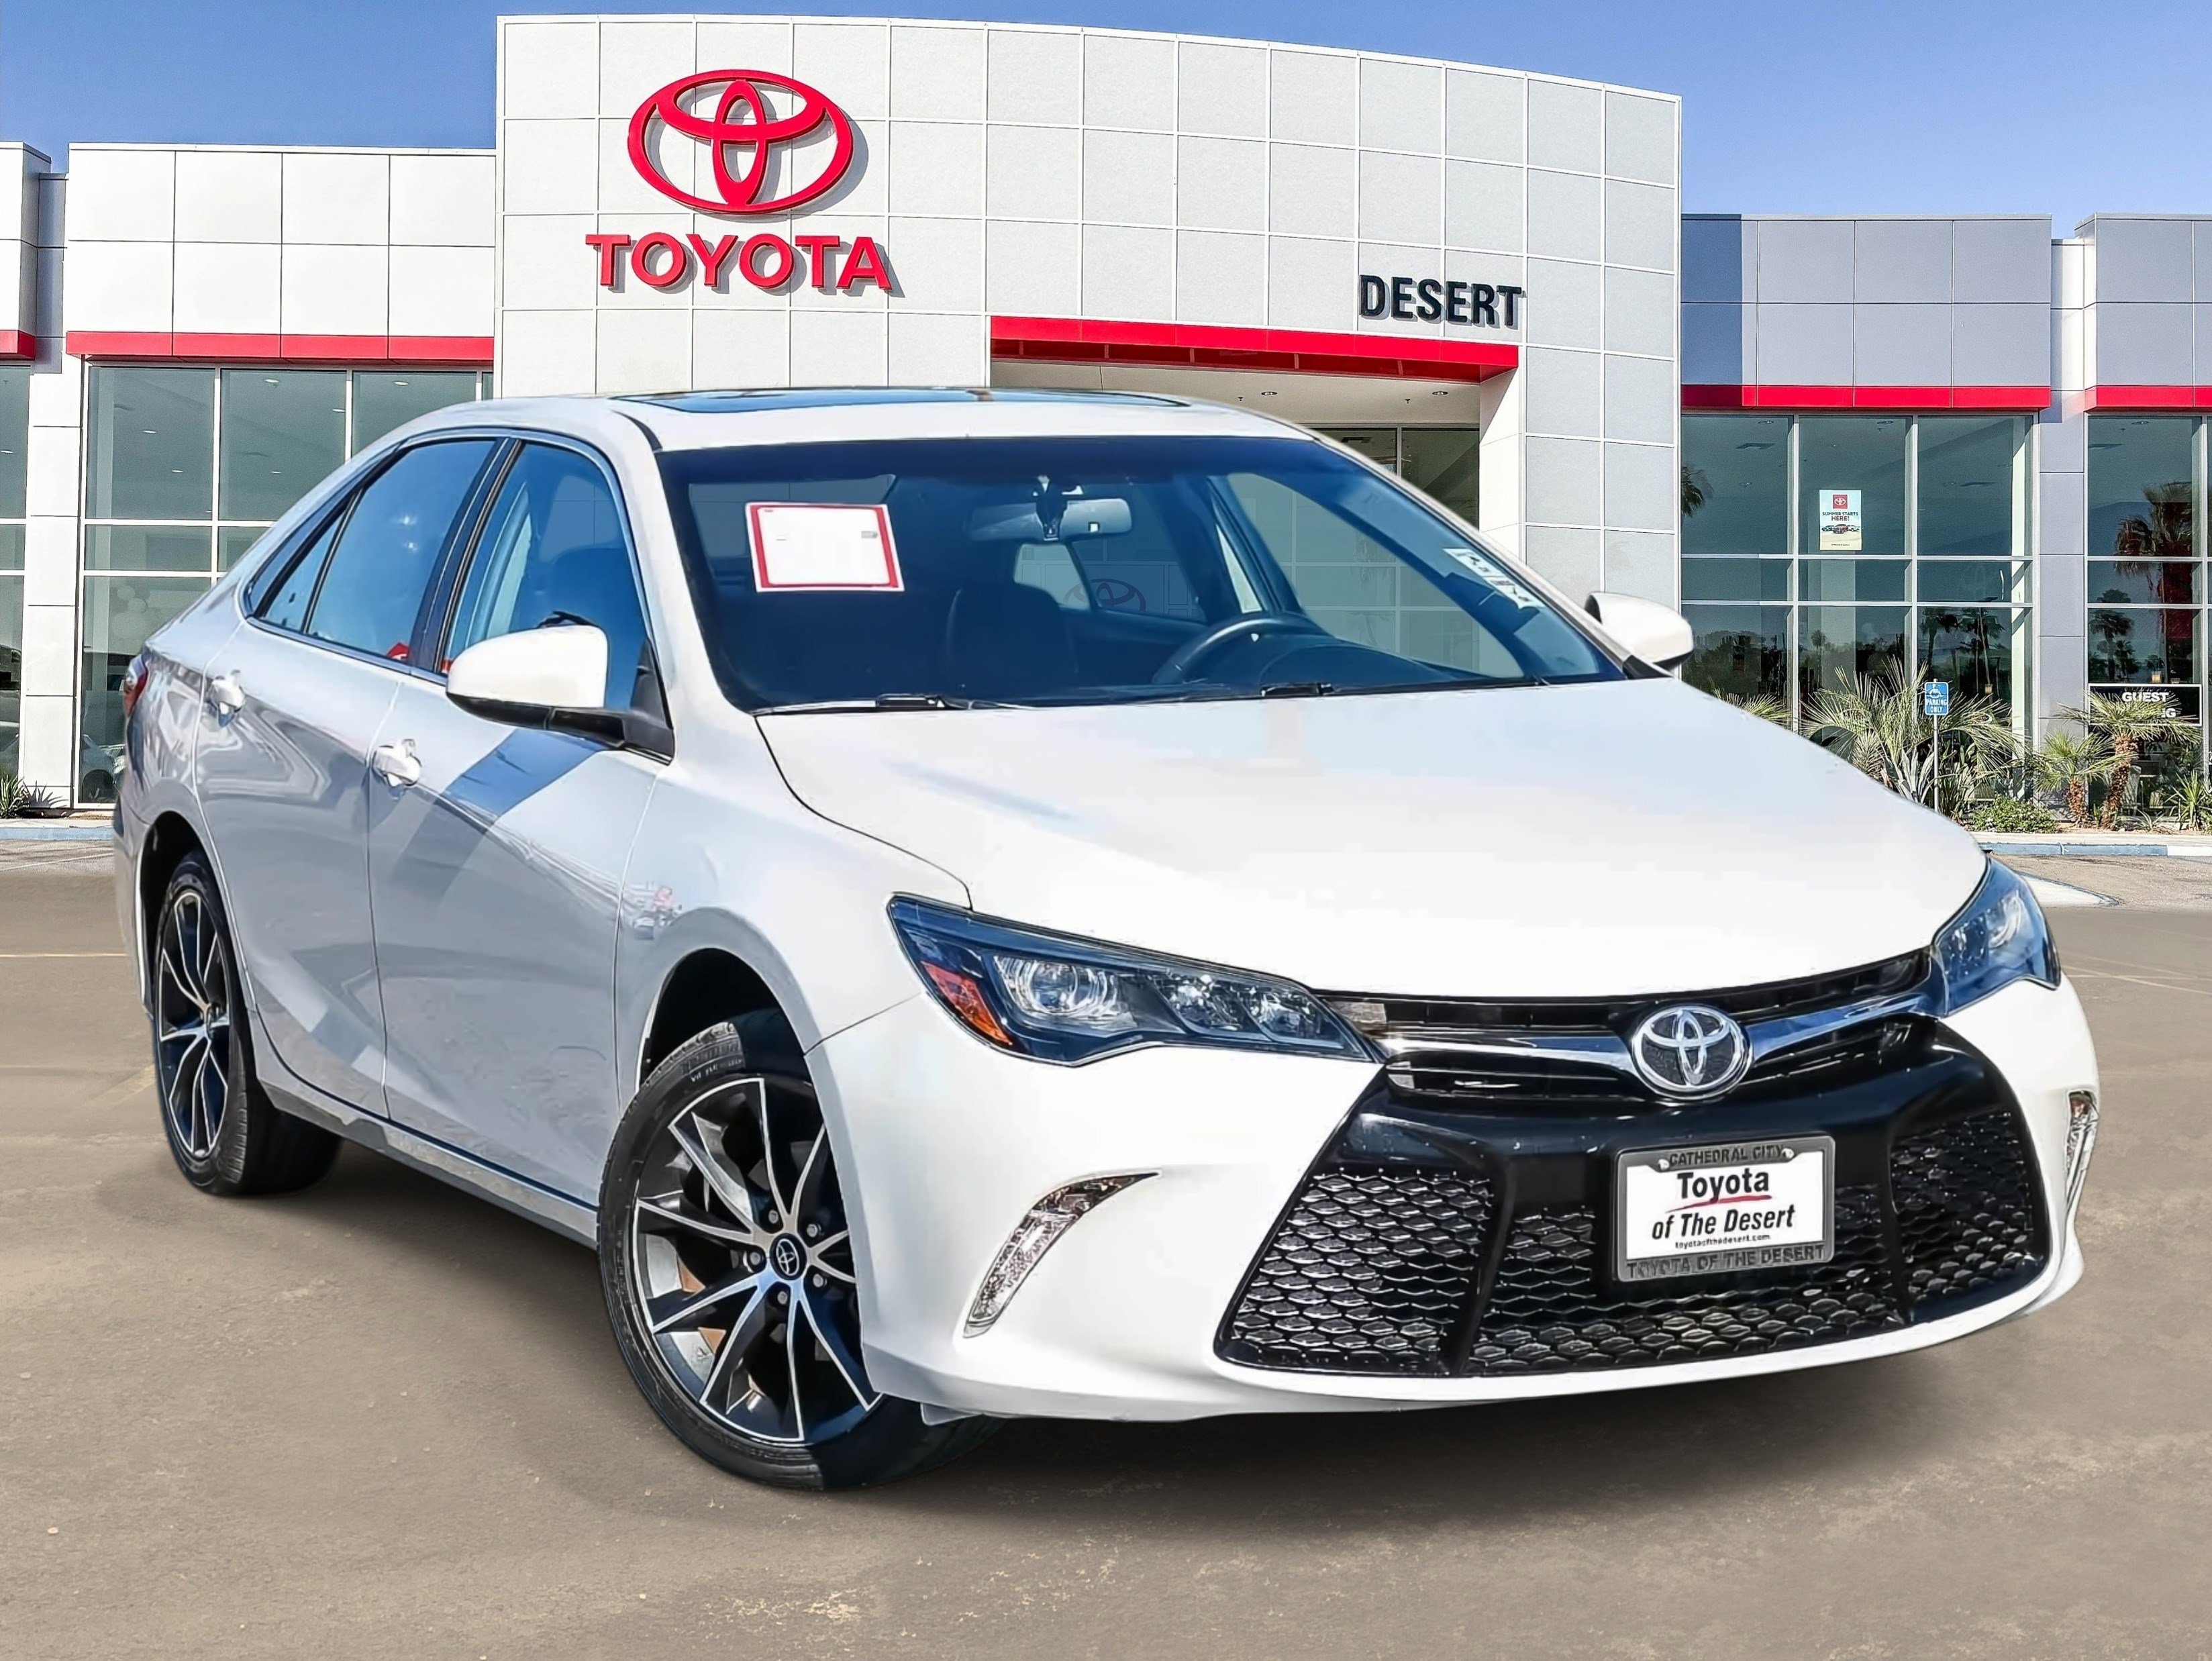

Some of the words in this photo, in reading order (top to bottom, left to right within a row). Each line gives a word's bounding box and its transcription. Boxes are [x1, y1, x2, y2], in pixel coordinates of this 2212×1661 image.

[585, 232, 893, 289] TOYOTA
[1359, 274, 1522, 327] DESERT
[2122, 691, 2169, 702] GUEST
[1669, 1148, 1747, 1166] CATHEDRAL
[1753, 1145, 1783, 1159] CITY
[1677, 1168, 1769, 1202] Toyota
[1652, 1215, 1674, 1240] of
[1680, 1213, 1716, 1236] The
[1724, 1205, 1795, 1233] Desert
[1675, 1234, 1770, 1249] toyotaofthedesert.com
[1627, 1259, 1691, 1278] TOYOTA
[1697, 1256, 1717, 1270] OF
[1724, 1251, 1756, 1267] THE
[1760, 1246, 1825, 1264] DESERT
